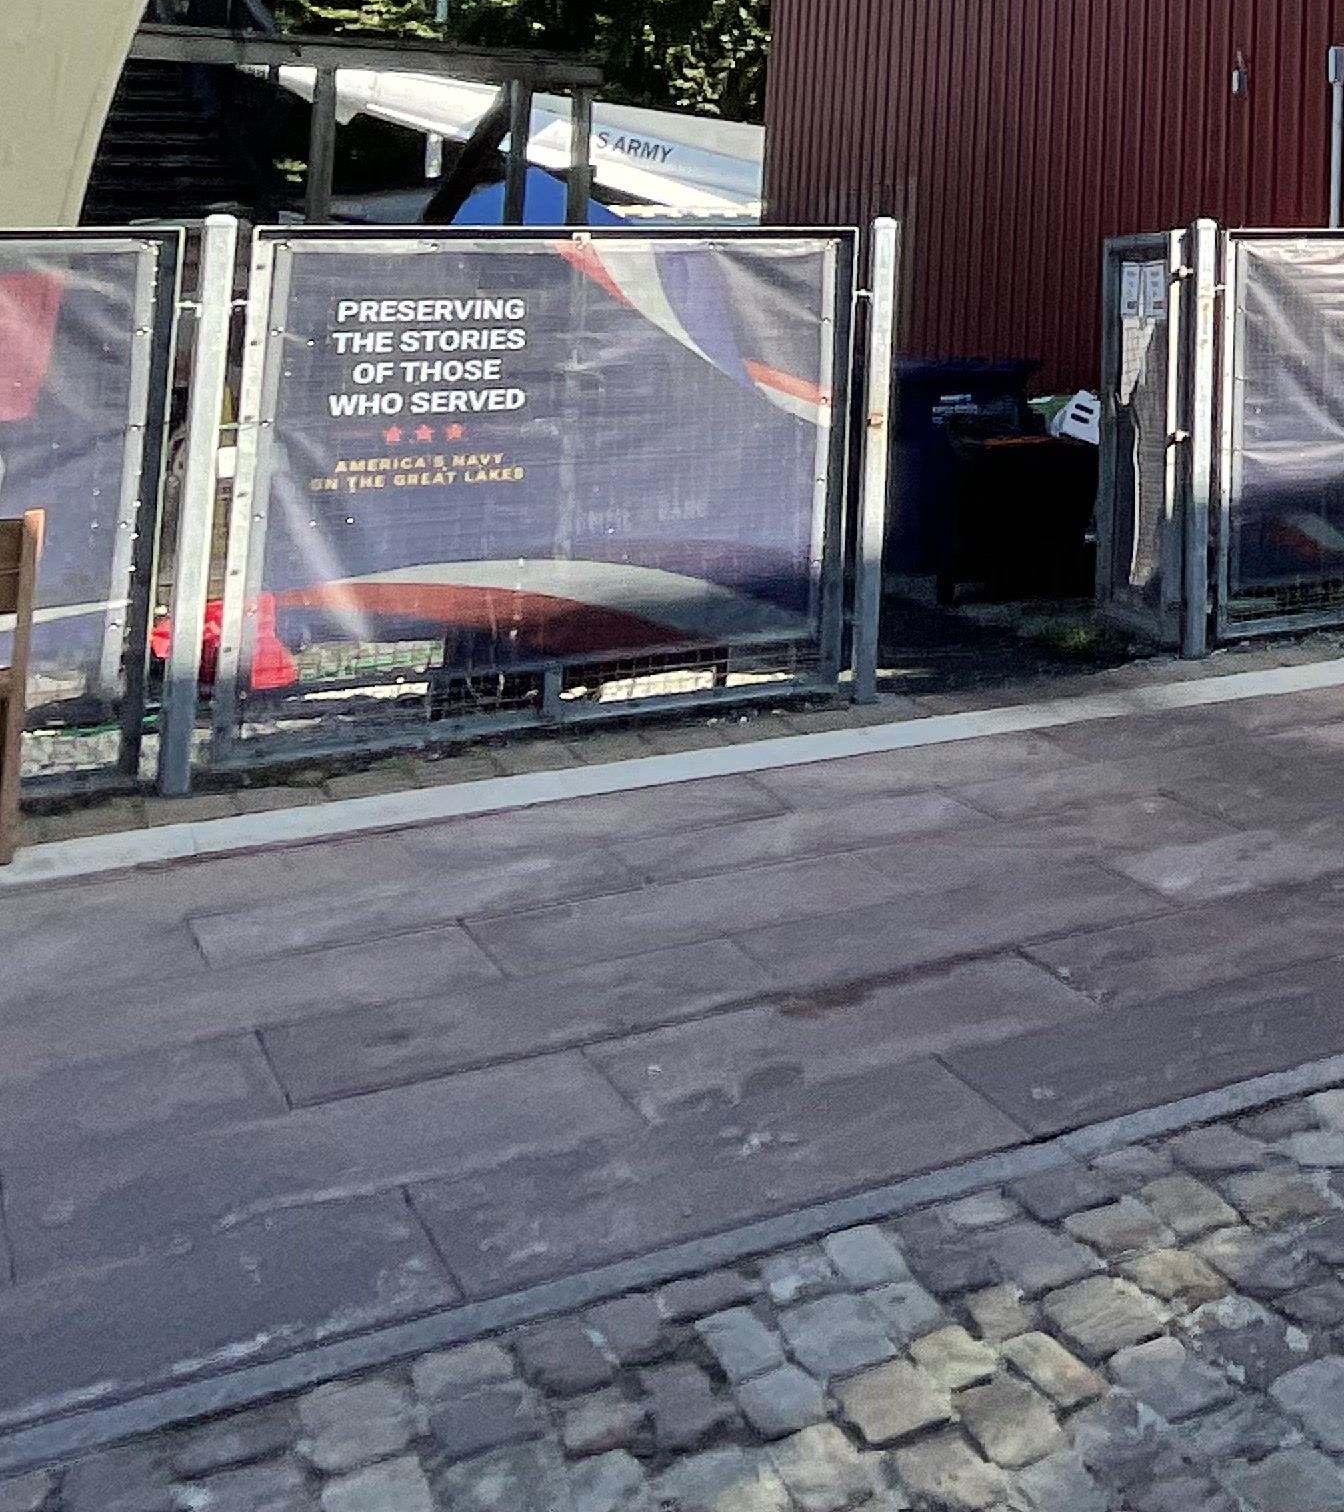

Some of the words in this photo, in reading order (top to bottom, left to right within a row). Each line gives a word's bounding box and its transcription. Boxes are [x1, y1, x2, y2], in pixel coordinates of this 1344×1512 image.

[613, 136, 674, 164] ARMY
[337, 298, 526, 323] PRESERVING
[332, 330, 395, 354] THE
[399, 328, 527, 352] STORIES
[352, 361, 395, 385] OF
[399, 358, 502, 383] THOSE
[329, 392, 404, 416] WHO
[410, 388, 527, 414] SERVED
[335, 454, 446, 473] AMERICA'S
[452, 453, 505, 467] NAVY
[310, 478, 339, 491] ON
[346, 474, 386, 491] THE
[393, 471, 457, 487] GREAT
[464, 466, 526, 483] LAKES
